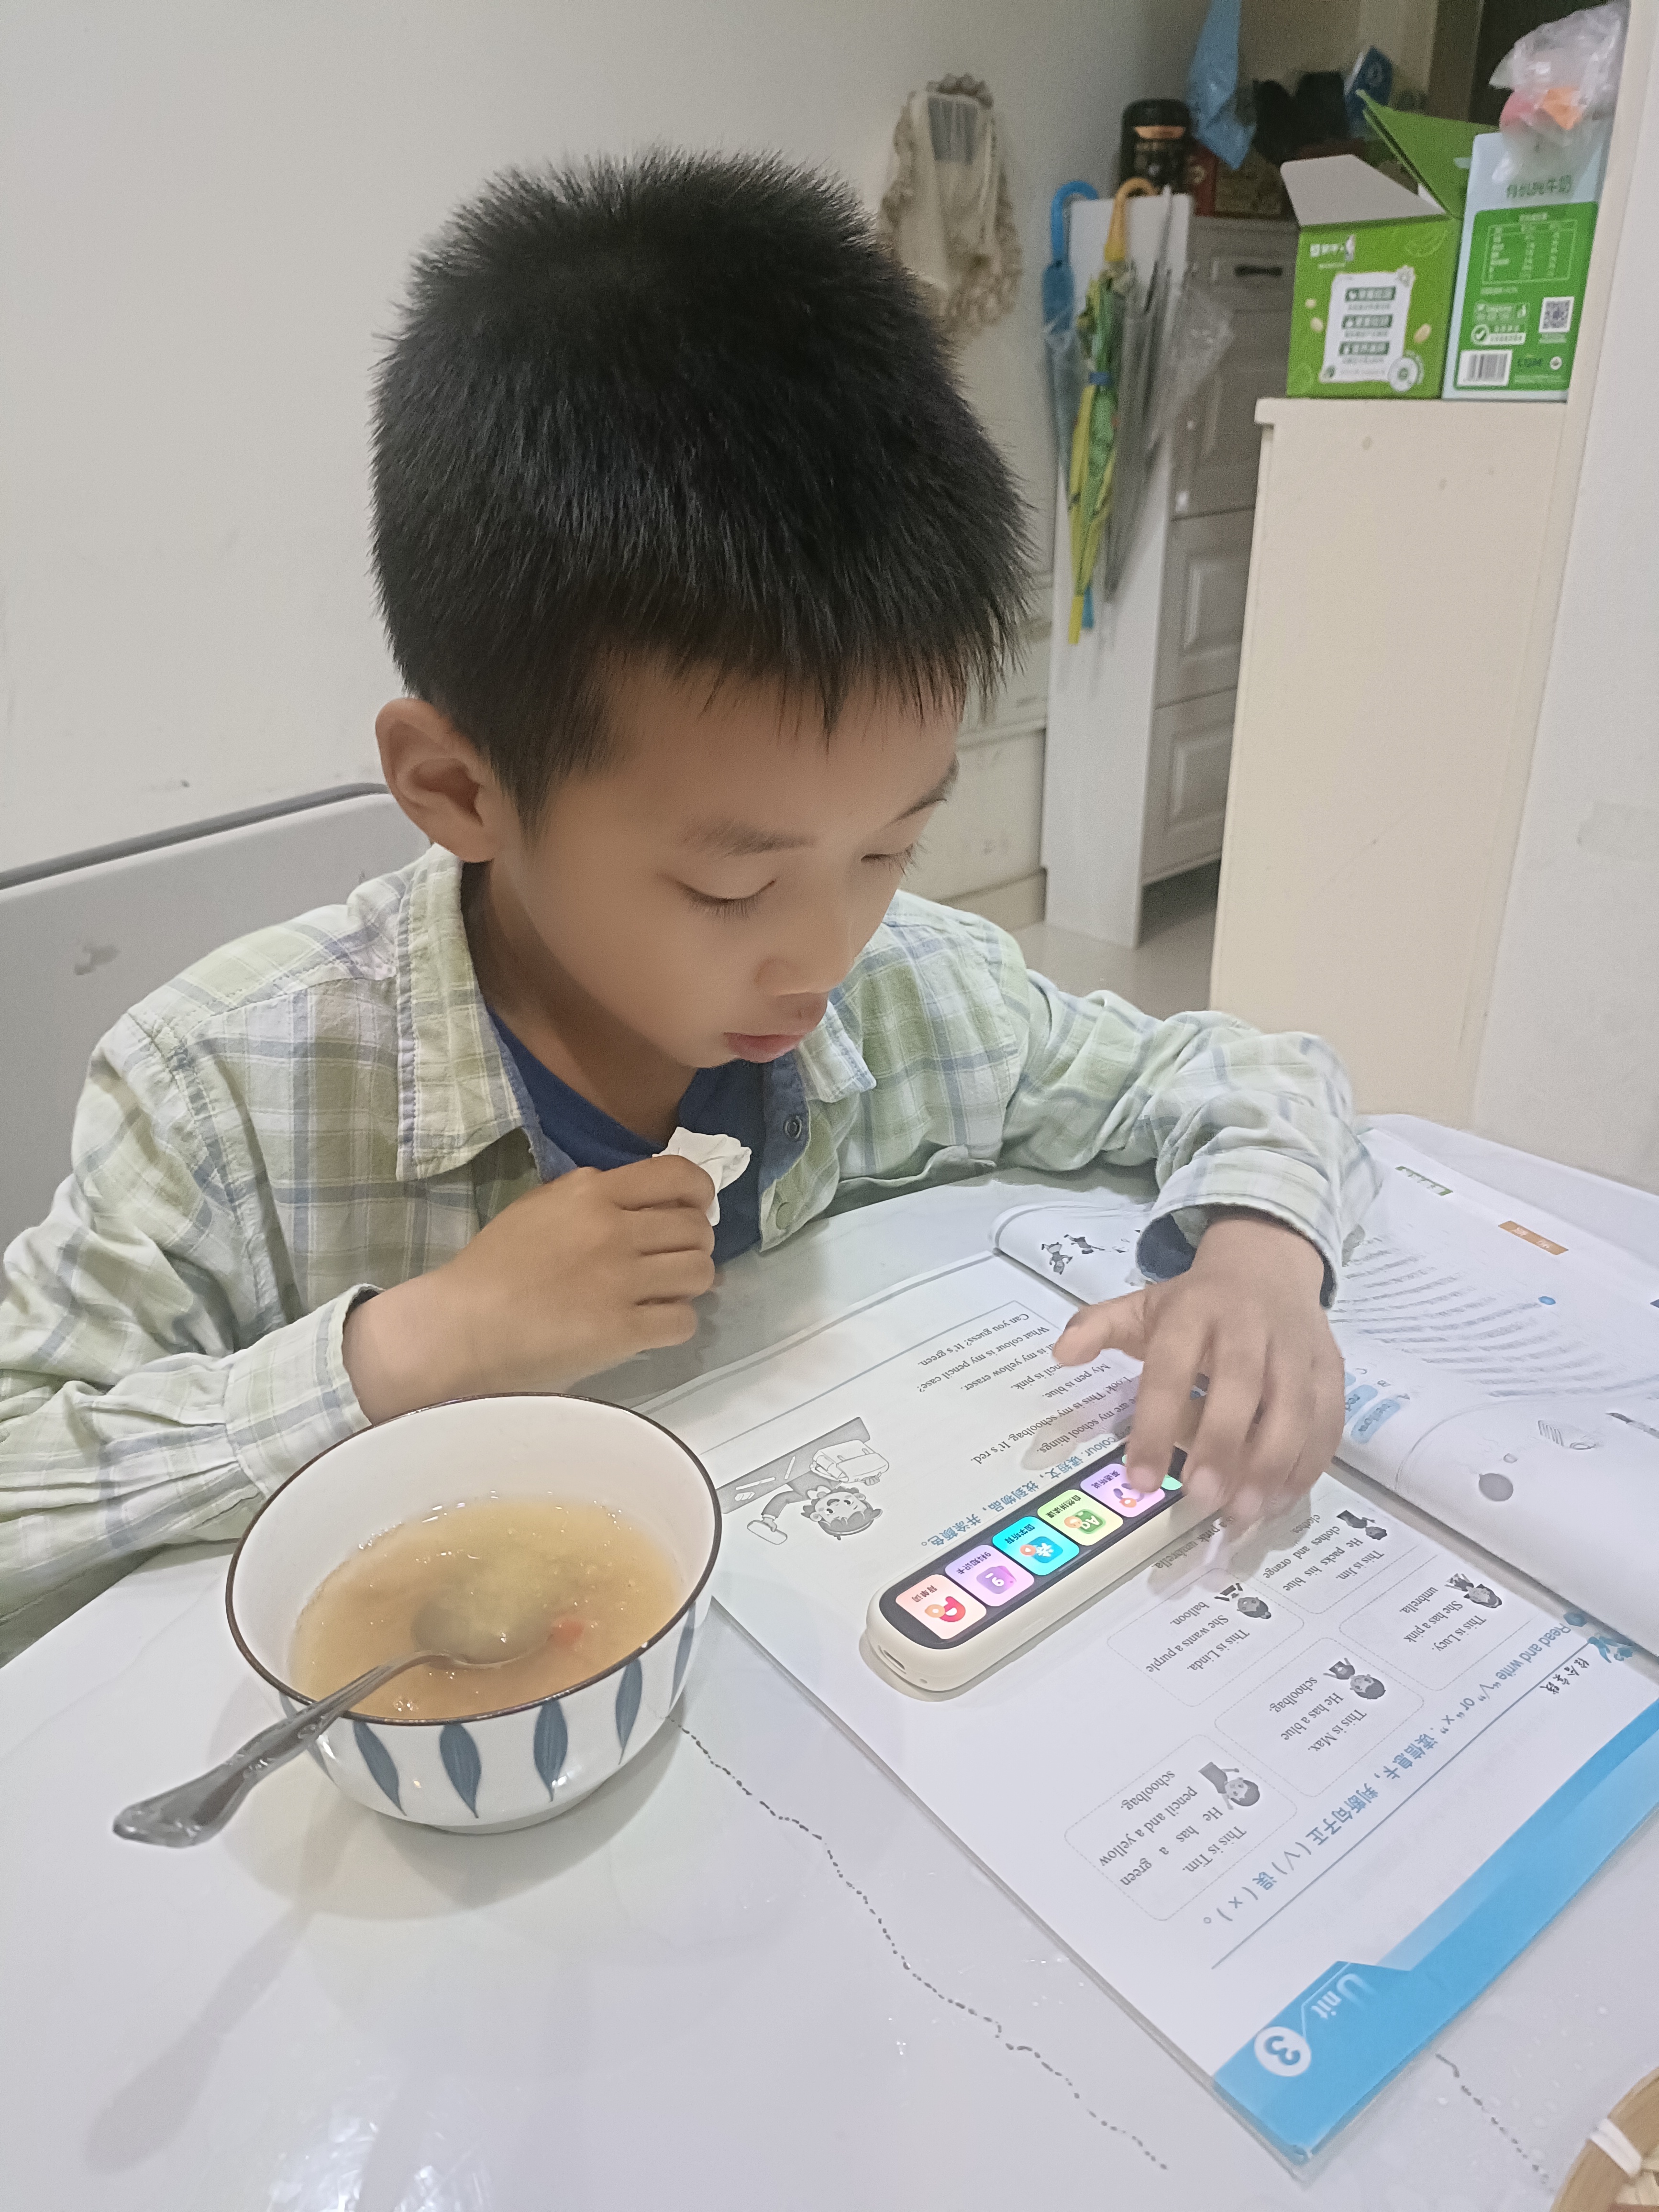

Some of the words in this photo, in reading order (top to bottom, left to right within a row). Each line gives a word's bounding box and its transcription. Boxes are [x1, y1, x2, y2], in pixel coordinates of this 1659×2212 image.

[992, 1320, 1010, 1331] you
[1009, 1314, 1029, 1323] Can
[964, 1328, 992, 1346] guess?
[1023, 1327, 1049, 1339] What
[995, 1337, 1023, 1352] colour
[918, 1350, 946, 1365] green.
[971, 1354, 986, 1363] my
[1022, 1353, 1037, 1361] my
[941, 1360, 970, 1379] pencil
[993, 1359, 1022, 1376] yellow
[1041, 1362, 1066, 1377] encil
[1092, 1364, 1111, 1373] My
[917, 1377, 941, 1392] case?
[961, 1375, 991, 1390] eraser.
[1011, 1376, 1035, 1390] pink.
[1074, 1371, 1092, 1382] pen
[1042, 1386, 1068, 1397] blue.
[1106, 1377, 1132, 1394] Look!
[1082, 1393, 1106, 1404] This
[1057, 1407, 1073, 1417] my
[1114, 1403, 1129, 1412] are
[1098, 1411, 1115, 1421] my
[1008, 1416, 1057, 1441] schoolbag.
[1068, 1419, 1099, 1438] school
[1037, 1435, 1070, 1453] things.
[1080, 1436, 1116, 1457] colour.
[971, 1451, 991, 1464] red.
[1090, 1469, 1120, 1490] 英语听说
[1044, 1493, 1081, 1518] 自然拼读课
[1003, 1523, 1035, 1545] 国学听背
[1311, 1526, 1340, 1545] clothes
[1346, 1538, 1363, 1547] He
[1293, 1546, 1310, 1559] and
[1320, 1547, 1345, 1565] packs
[1361, 1550, 1383, 1563] This
[954, 1550, 991, 1575] 9科知识卡
[1263, 1559, 1291, 1578] orange
[1305, 1566, 1322, 1576] his
[1336, 1568, 1358, 1579] Jim.
[1283, 1577, 1306, 1591] blue
[910, 1583, 937, 1603] 背单词
[1400, 1587, 1438, 1613] umbrella.
[1170, 1602, 1209, 1625] balloon.
[1443, 1601, 1463, 1614] She
[1208, 1615, 1228, 1628] She
[1428, 1612, 1448, 1624] has
[1463, 1615, 1486, 1629] This
[1182, 1628, 1209, 1647] wants
[1225, 1629, 1250, 1644] This
[1404, 1626, 1425, 1642] pink
[1538, 1623, 1571, 1647] Read
[1216, 1643, 1229, 1651] is
[1432, 1634, 1461, 1651] Lucy.
[1146, 1648, 1177, 1672] purple
[1187, 1650, 1220, 1670] Linda.
[1519, 1644, 1542, 1663] and
[1495, 1660, 1521, 1680] write
[1270, 1677, 1317, 1713] schoolbag.
[1325, 1692, 1344, 1705] He
[1308, 1704, 1329, 1718] has
[1460, 1698, 1475, 1711] or
[1341, 1709, 1366, 1726] This
[1281, 1723, 1306, 1740] blue
[1332, 1725, 1346, 1734] is
[1308, 1733, 1337, 1751] Max.
[1121, 1771, 1175, 1810] schoolbag.
[1165, 1786, 1197, 1816] pencil
[1203, 1807, 1223, 1821] He
[1144, 1813, 1165, 1833] and
[1176, 1826, 1199, 1842] has
[1218, 1826, 1246, 1845] This
[1099, 1834, 1136, 1866] yellow
[1208, 1844, 1223, 1854] is
[1183, 1854, 1212, 1871] Tim.
[1120, 1858, 1151, 1885] green
[1309, 1973, 1377, 2021] Unit
[1263, 2037, 1300, 2067] 3
